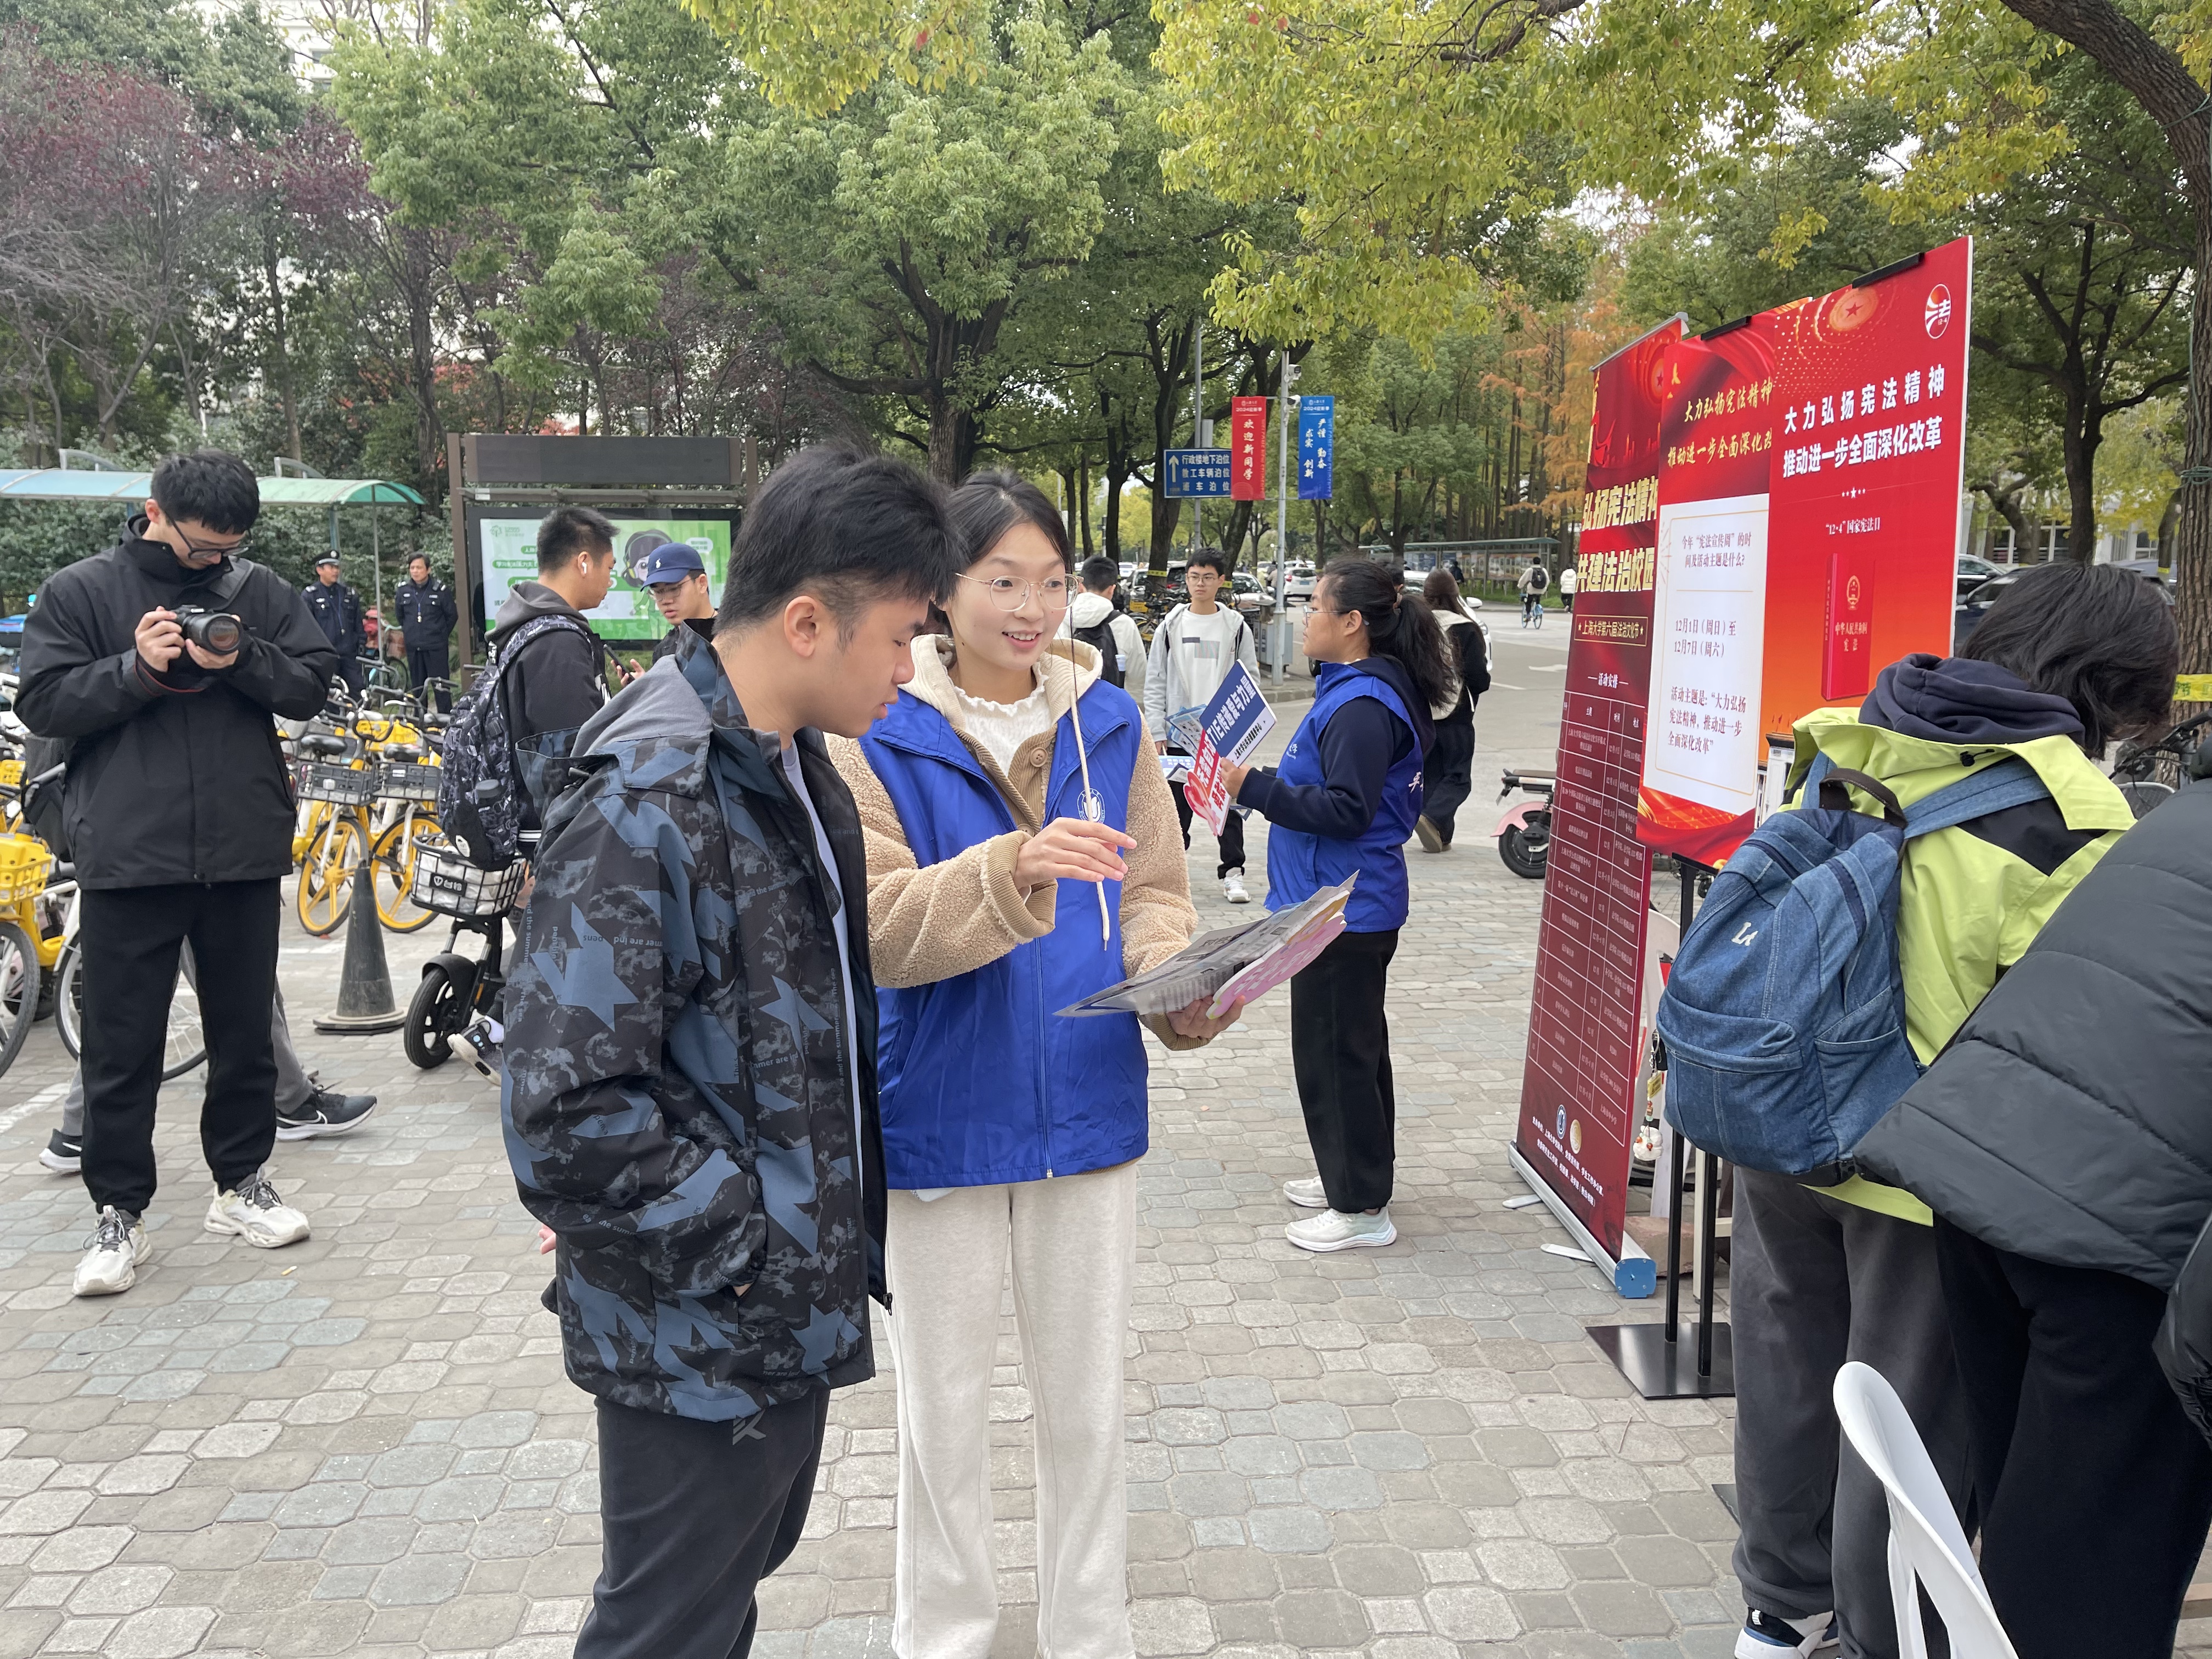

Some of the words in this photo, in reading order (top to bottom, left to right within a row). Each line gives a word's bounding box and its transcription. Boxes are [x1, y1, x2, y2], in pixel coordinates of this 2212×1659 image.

[1684, 376, 1773, 422] 大力弘扬宪法精神
[1785, 364, 1946, 435] 大力弘扬宪法精神
[1243, 419, 1255, 480] 欢迎新同学
[1783, 416, 1942, 478] 推动进一步全面深化改革
[1182, 454, 1229, 465] 行政楼地下泊位
[1304, 459, 1314, 479] 创新
[1582, 475, 1658, 532] 弘扬宪法精神
[1575, 547, 1655, 593] 共建法治校园
[1598, 672, 1618, 689] 活动安排
[525, 916, 534, 930] the
[613, 936, 628, 945] ind
[629, 938, 644, 946] are
[776, 1056, 788, 1064] are
